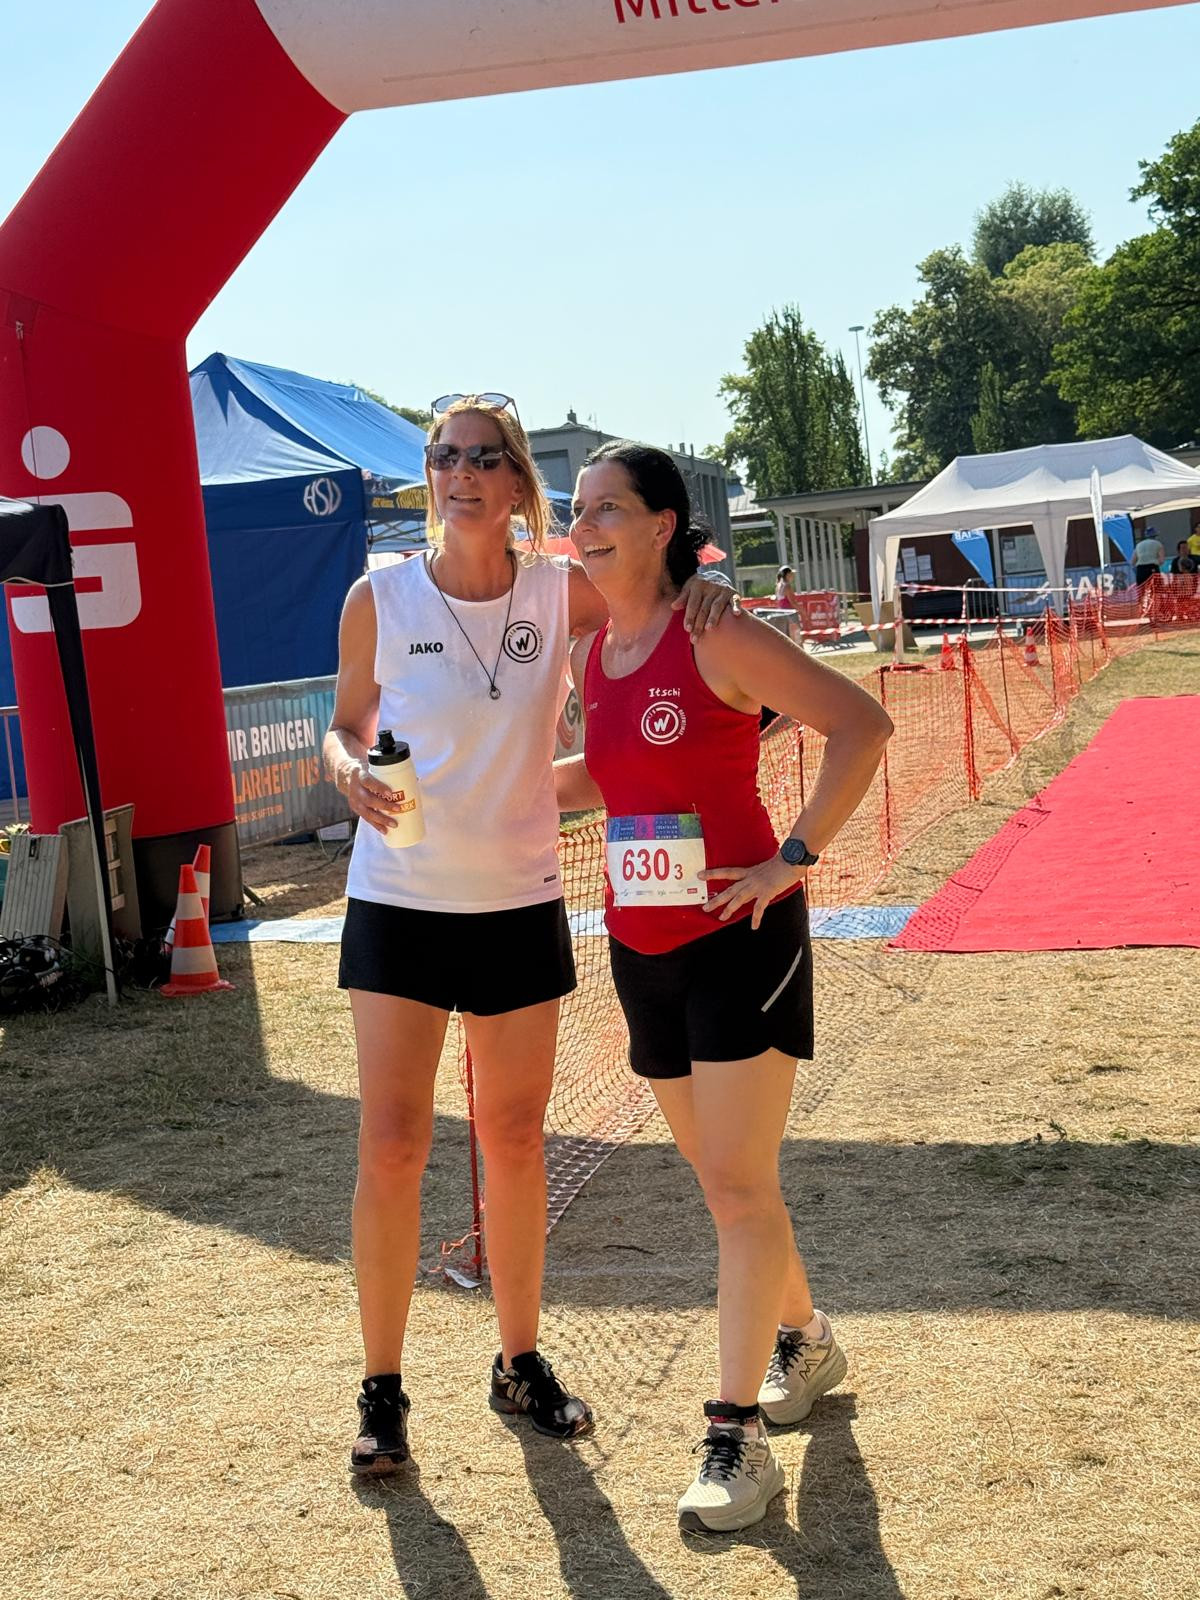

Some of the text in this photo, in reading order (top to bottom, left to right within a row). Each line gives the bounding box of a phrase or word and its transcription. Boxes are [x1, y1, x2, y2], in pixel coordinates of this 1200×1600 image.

[408, 642, 444, 655] JAKO
[250, 717, 316, 758] BRINGEN
[231, 760, 293, 804] LARHEIT
[622, 848, 683, 881] 630 3
